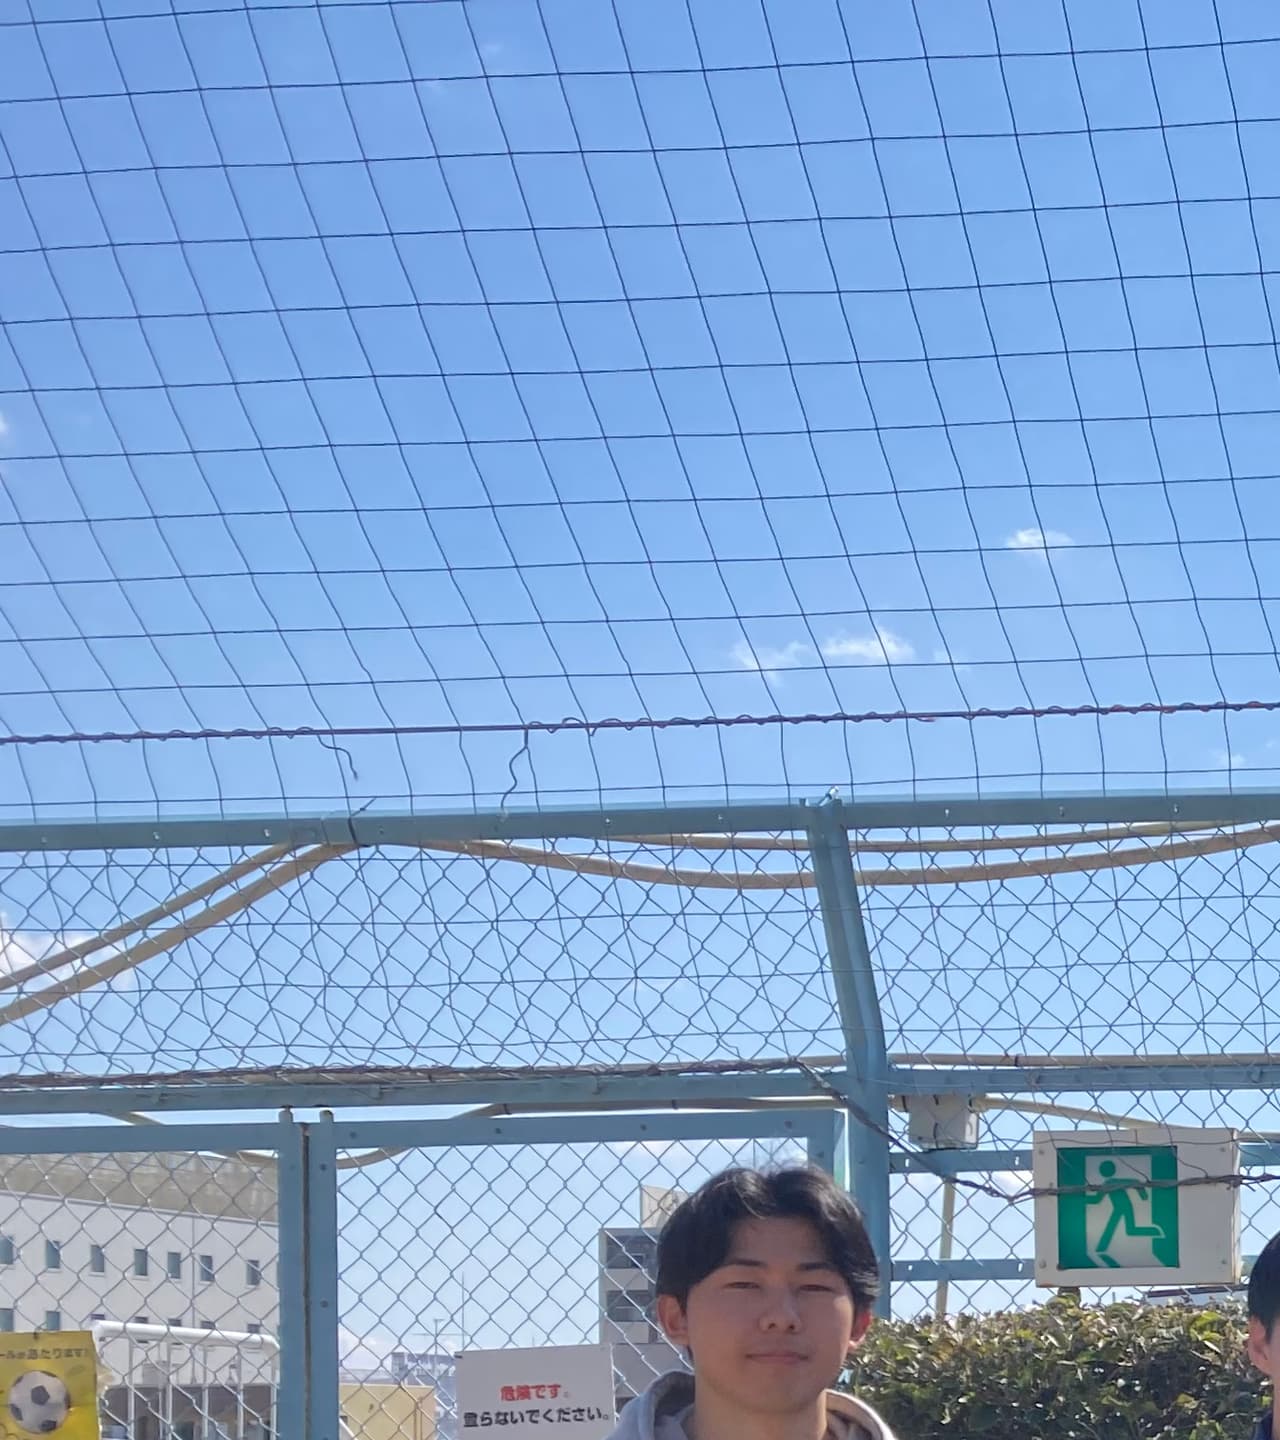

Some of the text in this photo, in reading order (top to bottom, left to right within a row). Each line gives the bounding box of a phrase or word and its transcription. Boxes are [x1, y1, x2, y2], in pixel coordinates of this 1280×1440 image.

[463, 1406, 609, 1427] 登らないでください。
